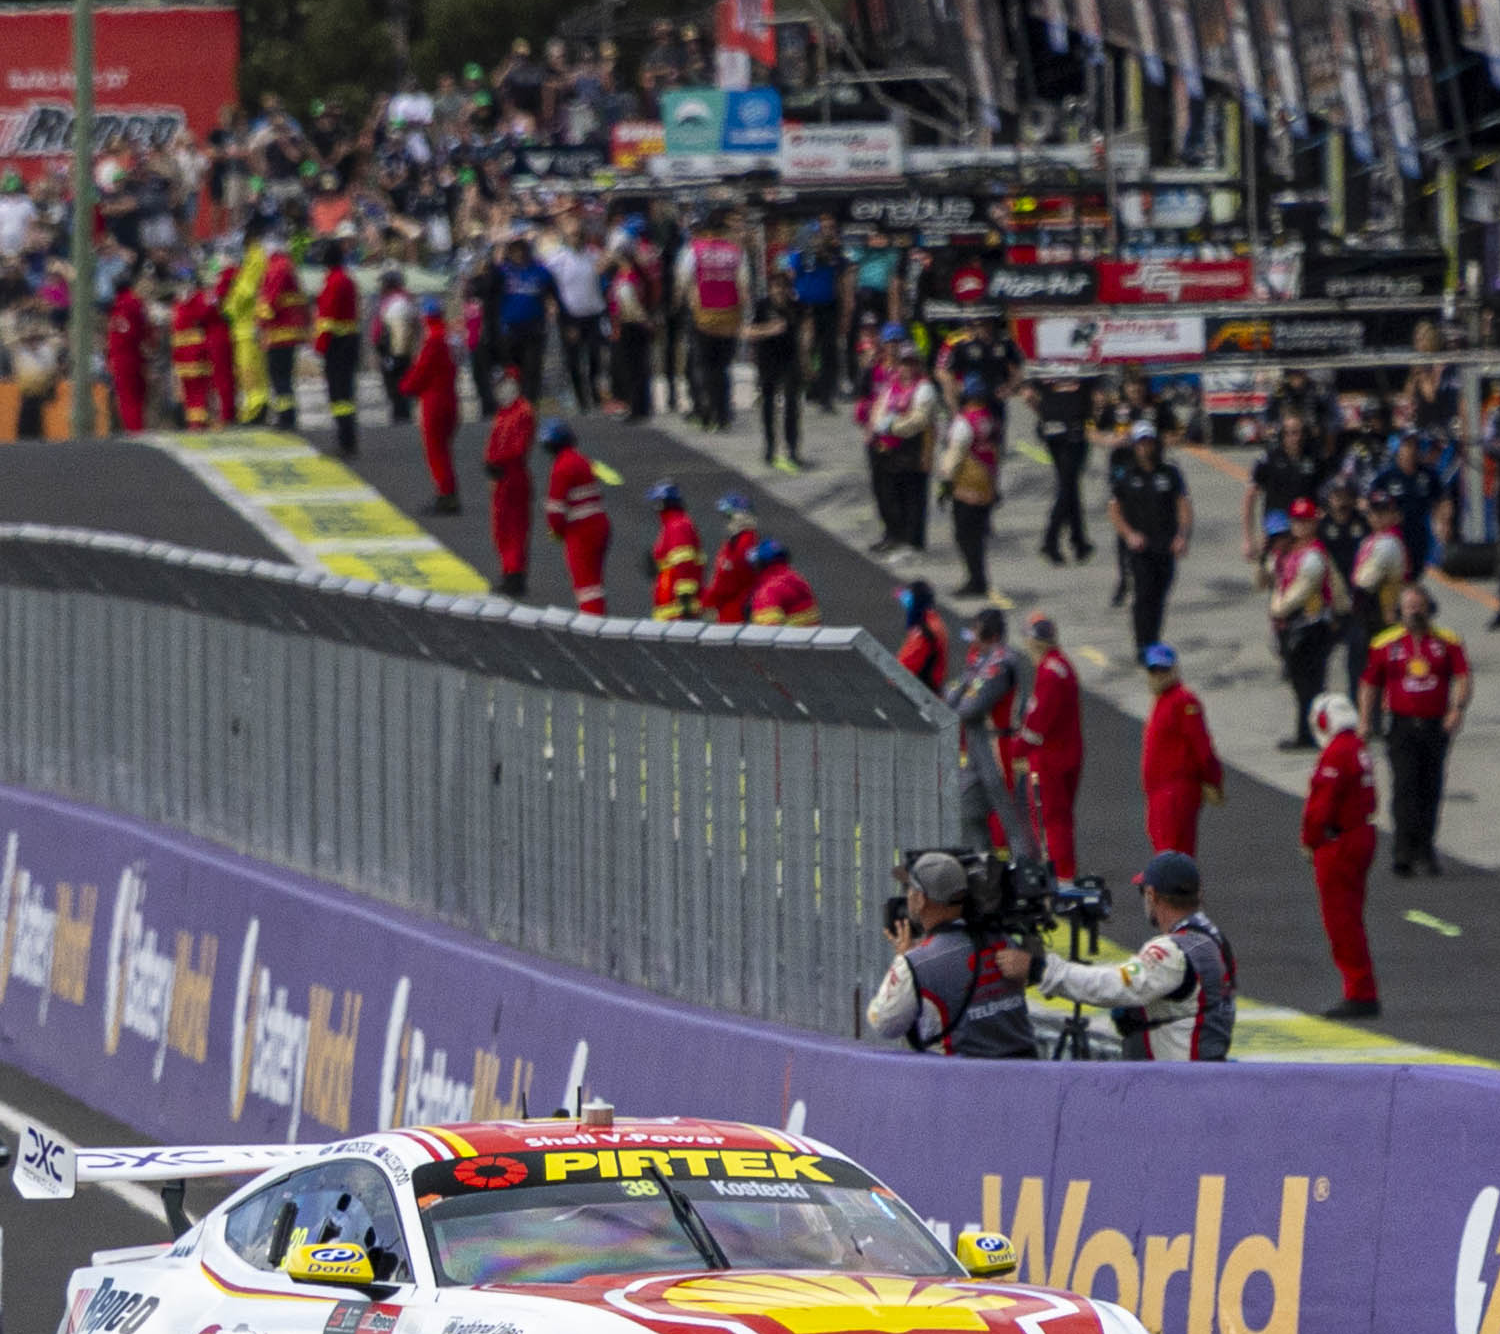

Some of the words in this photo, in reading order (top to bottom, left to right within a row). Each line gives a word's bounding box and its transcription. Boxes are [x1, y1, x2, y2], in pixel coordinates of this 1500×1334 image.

[524, 1132, 597, 1149] Shell
[599, 1132, 726, 1147] V-Power
[24, 1125, 66, 1182] DXC
[544, 1148, 836, 1184] PIRTEK
[621, 1180, 660, 1197] 38
[709, 1179, 811, 1200] Kostecki
[307, 1262, 361, 1276] Doric
